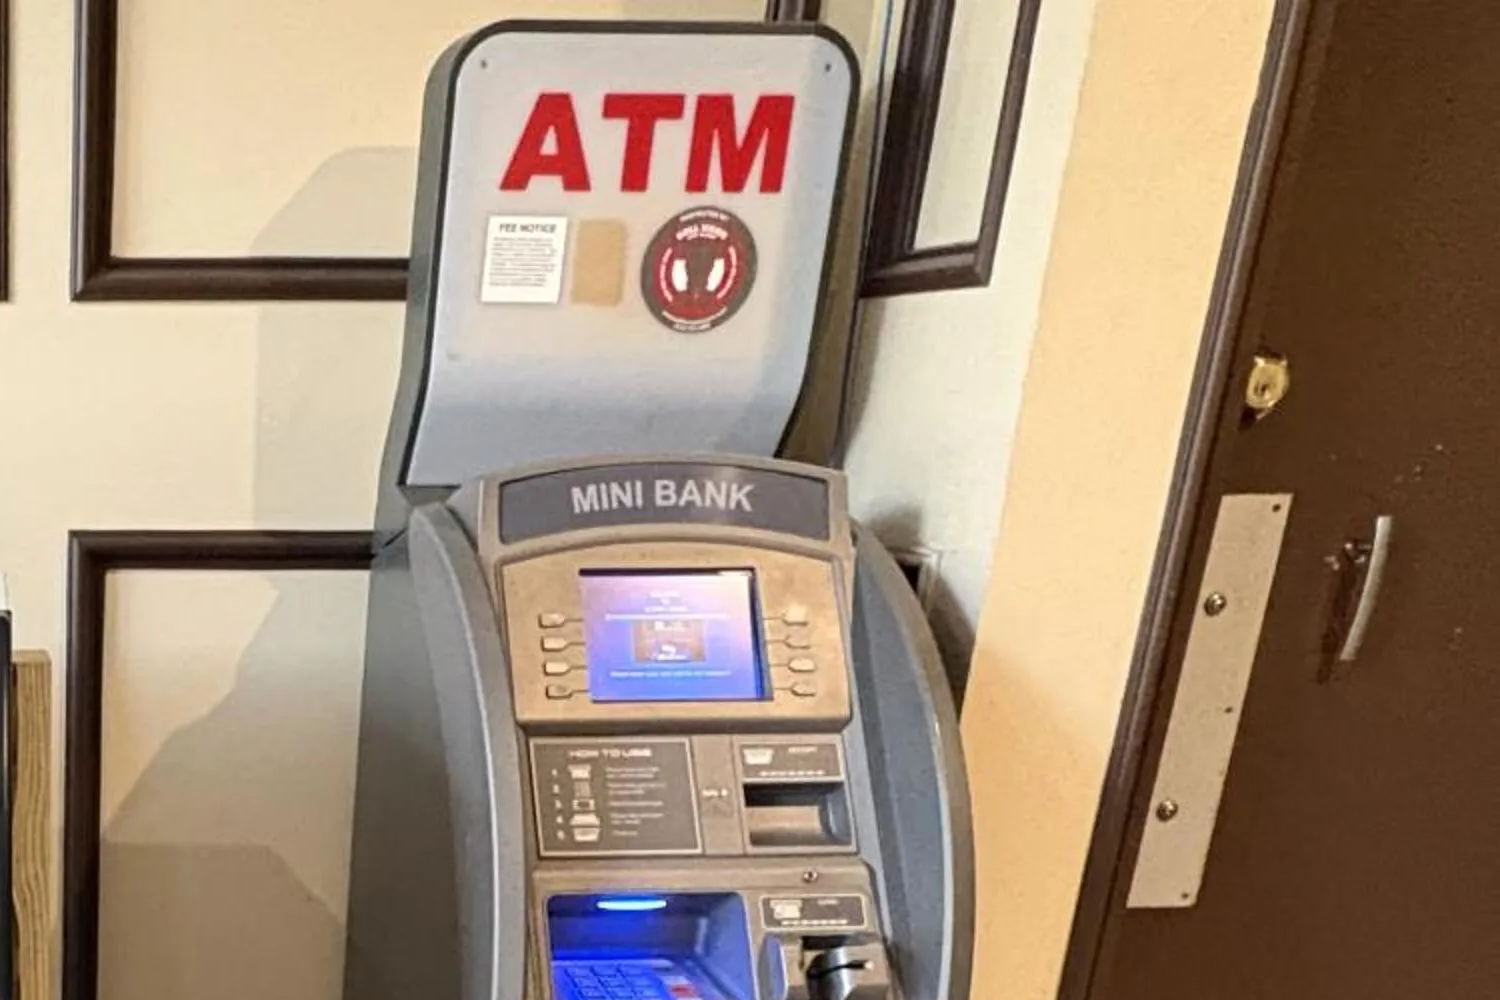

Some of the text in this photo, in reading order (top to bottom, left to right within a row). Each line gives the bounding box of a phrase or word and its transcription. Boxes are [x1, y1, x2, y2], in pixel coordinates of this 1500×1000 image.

[499, 92, 796, 193] ATM
[571, 478, 756, 514] MINI BANK
